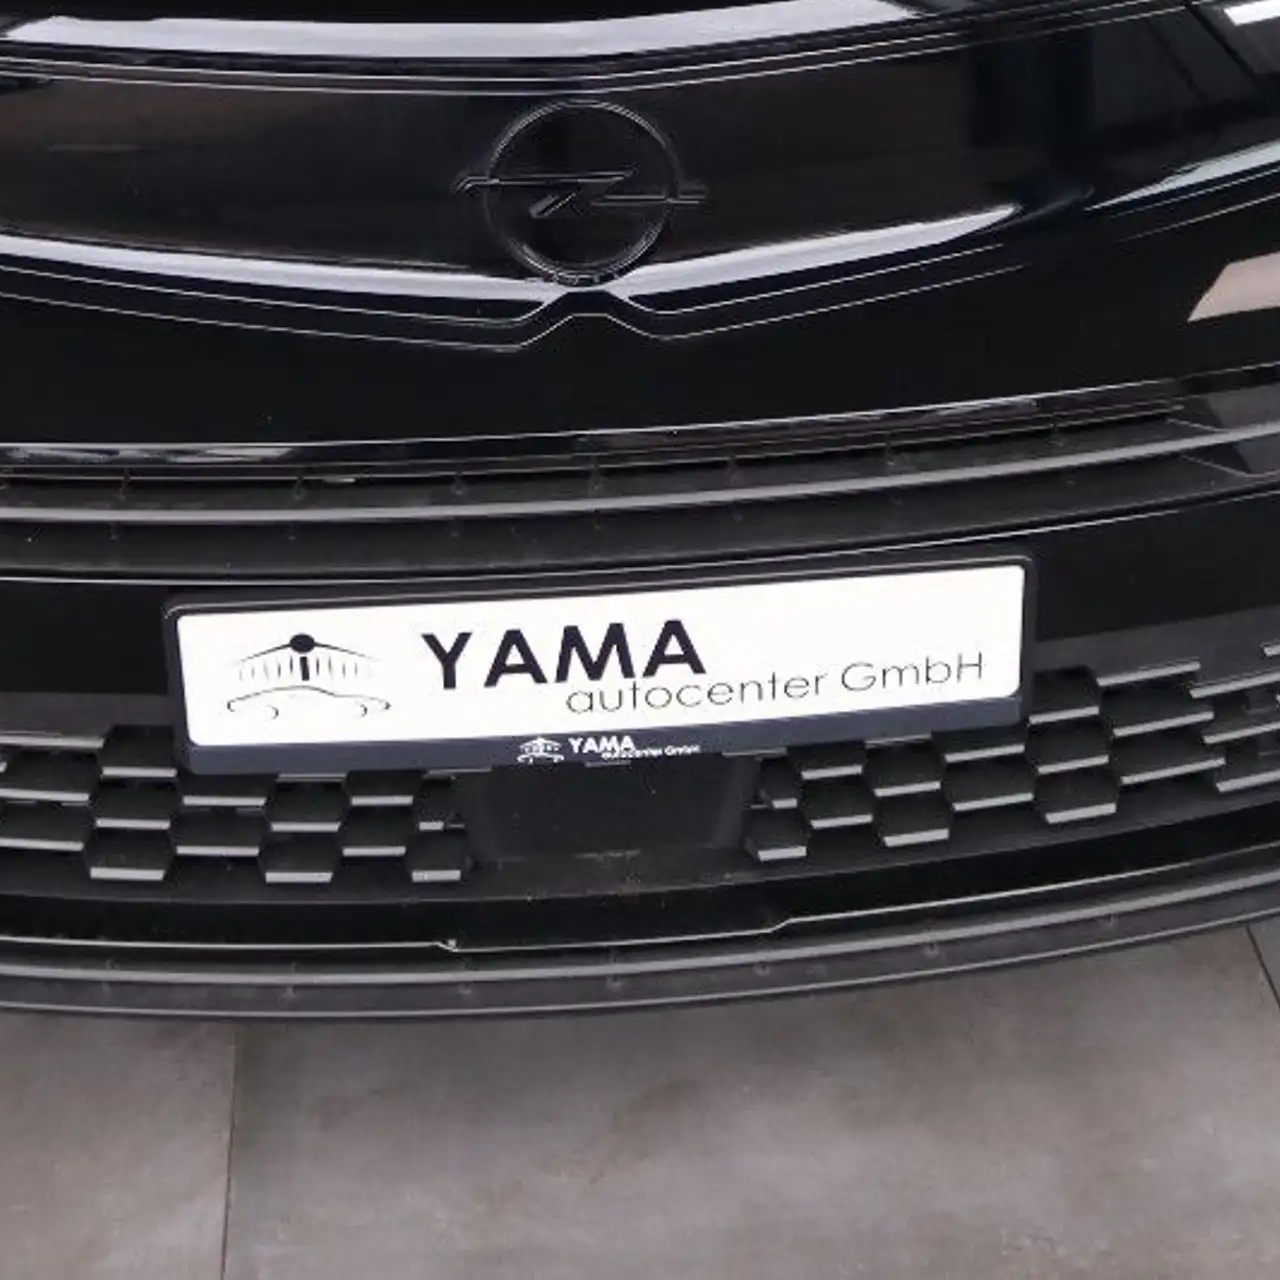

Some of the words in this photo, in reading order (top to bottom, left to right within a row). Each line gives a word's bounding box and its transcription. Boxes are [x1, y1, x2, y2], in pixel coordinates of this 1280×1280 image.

[421, 618, 707, 691] YAMA
[566, 672, 825, 714] autocenter
[841, 652, 983, 692] GmbH
[569, 736, 636, 755] YAMA
